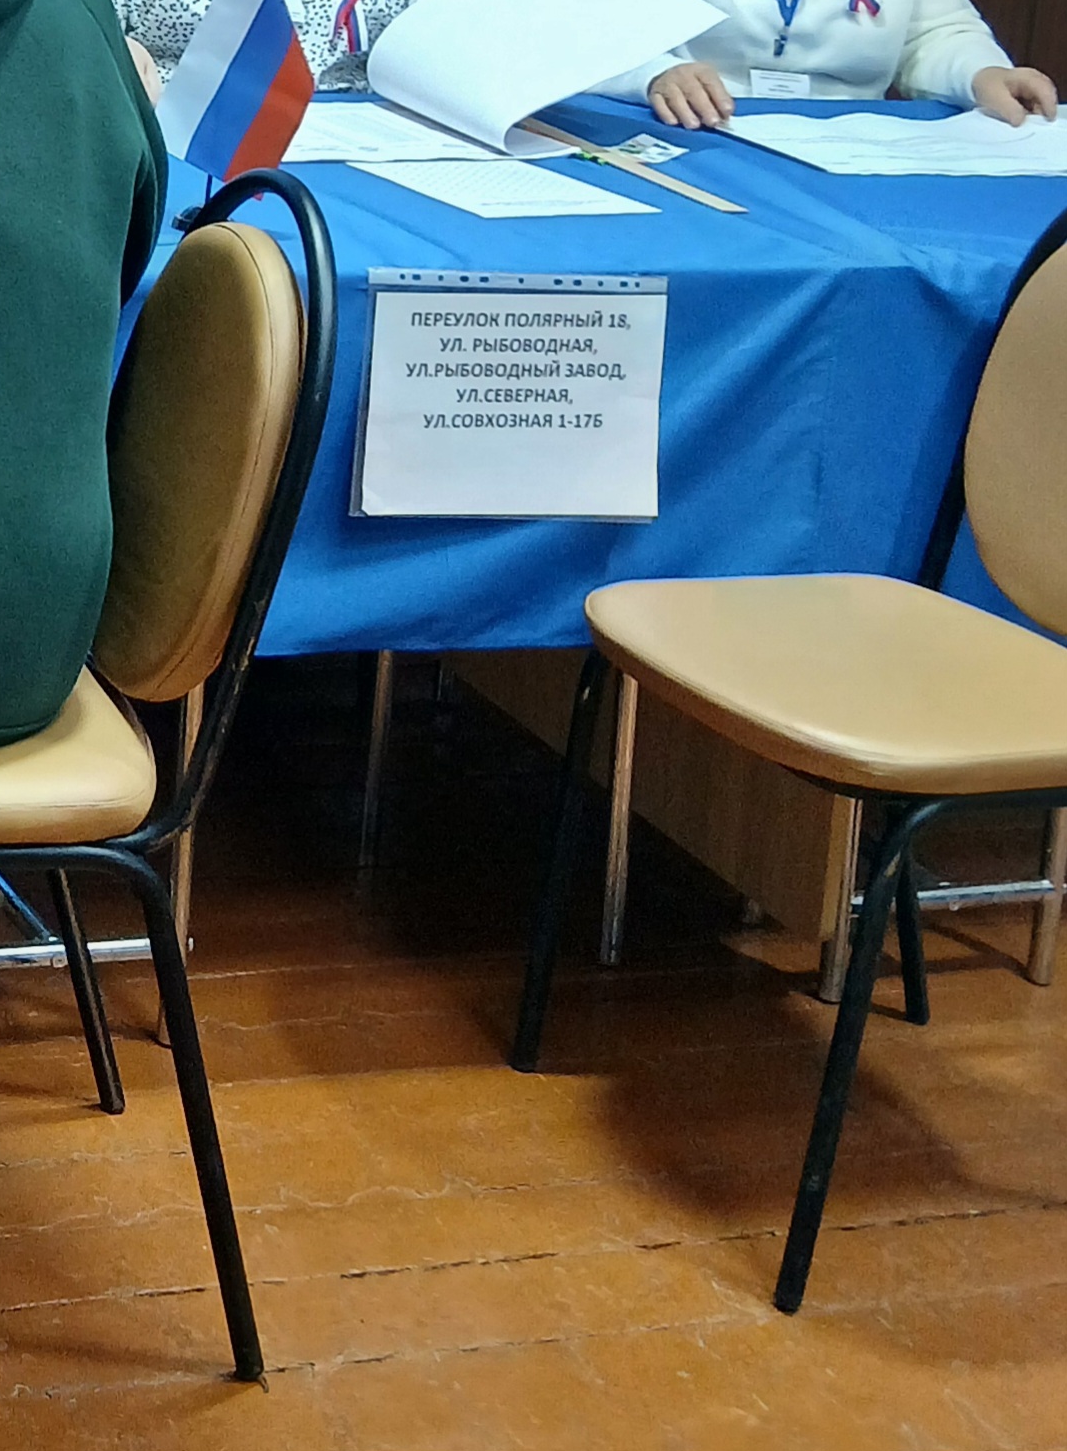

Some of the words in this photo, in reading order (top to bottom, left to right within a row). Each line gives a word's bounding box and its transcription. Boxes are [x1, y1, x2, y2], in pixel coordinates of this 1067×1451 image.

[411, 312, 499, 327] ПЕРЕУЛОК
[504, 311, 603, 328] ПОЛЯРНЫЙ
[439, 338, 466, 353] УЛ.
[473, 338, 598, 355] РЫБОВОДНАЯ,
[406, 361, 560, 380] УЛ.РЫБОВОДНЫЙ
[564, 363, 626, 380] ЗАВОД,
[456, 388, 573, 405] УЛ.СЕВЕРНАЯ,
[423, 414, 552, 429] УЛ.СОВХОЗНАЯ
[557, 414, 603, 428] 1-17Б
